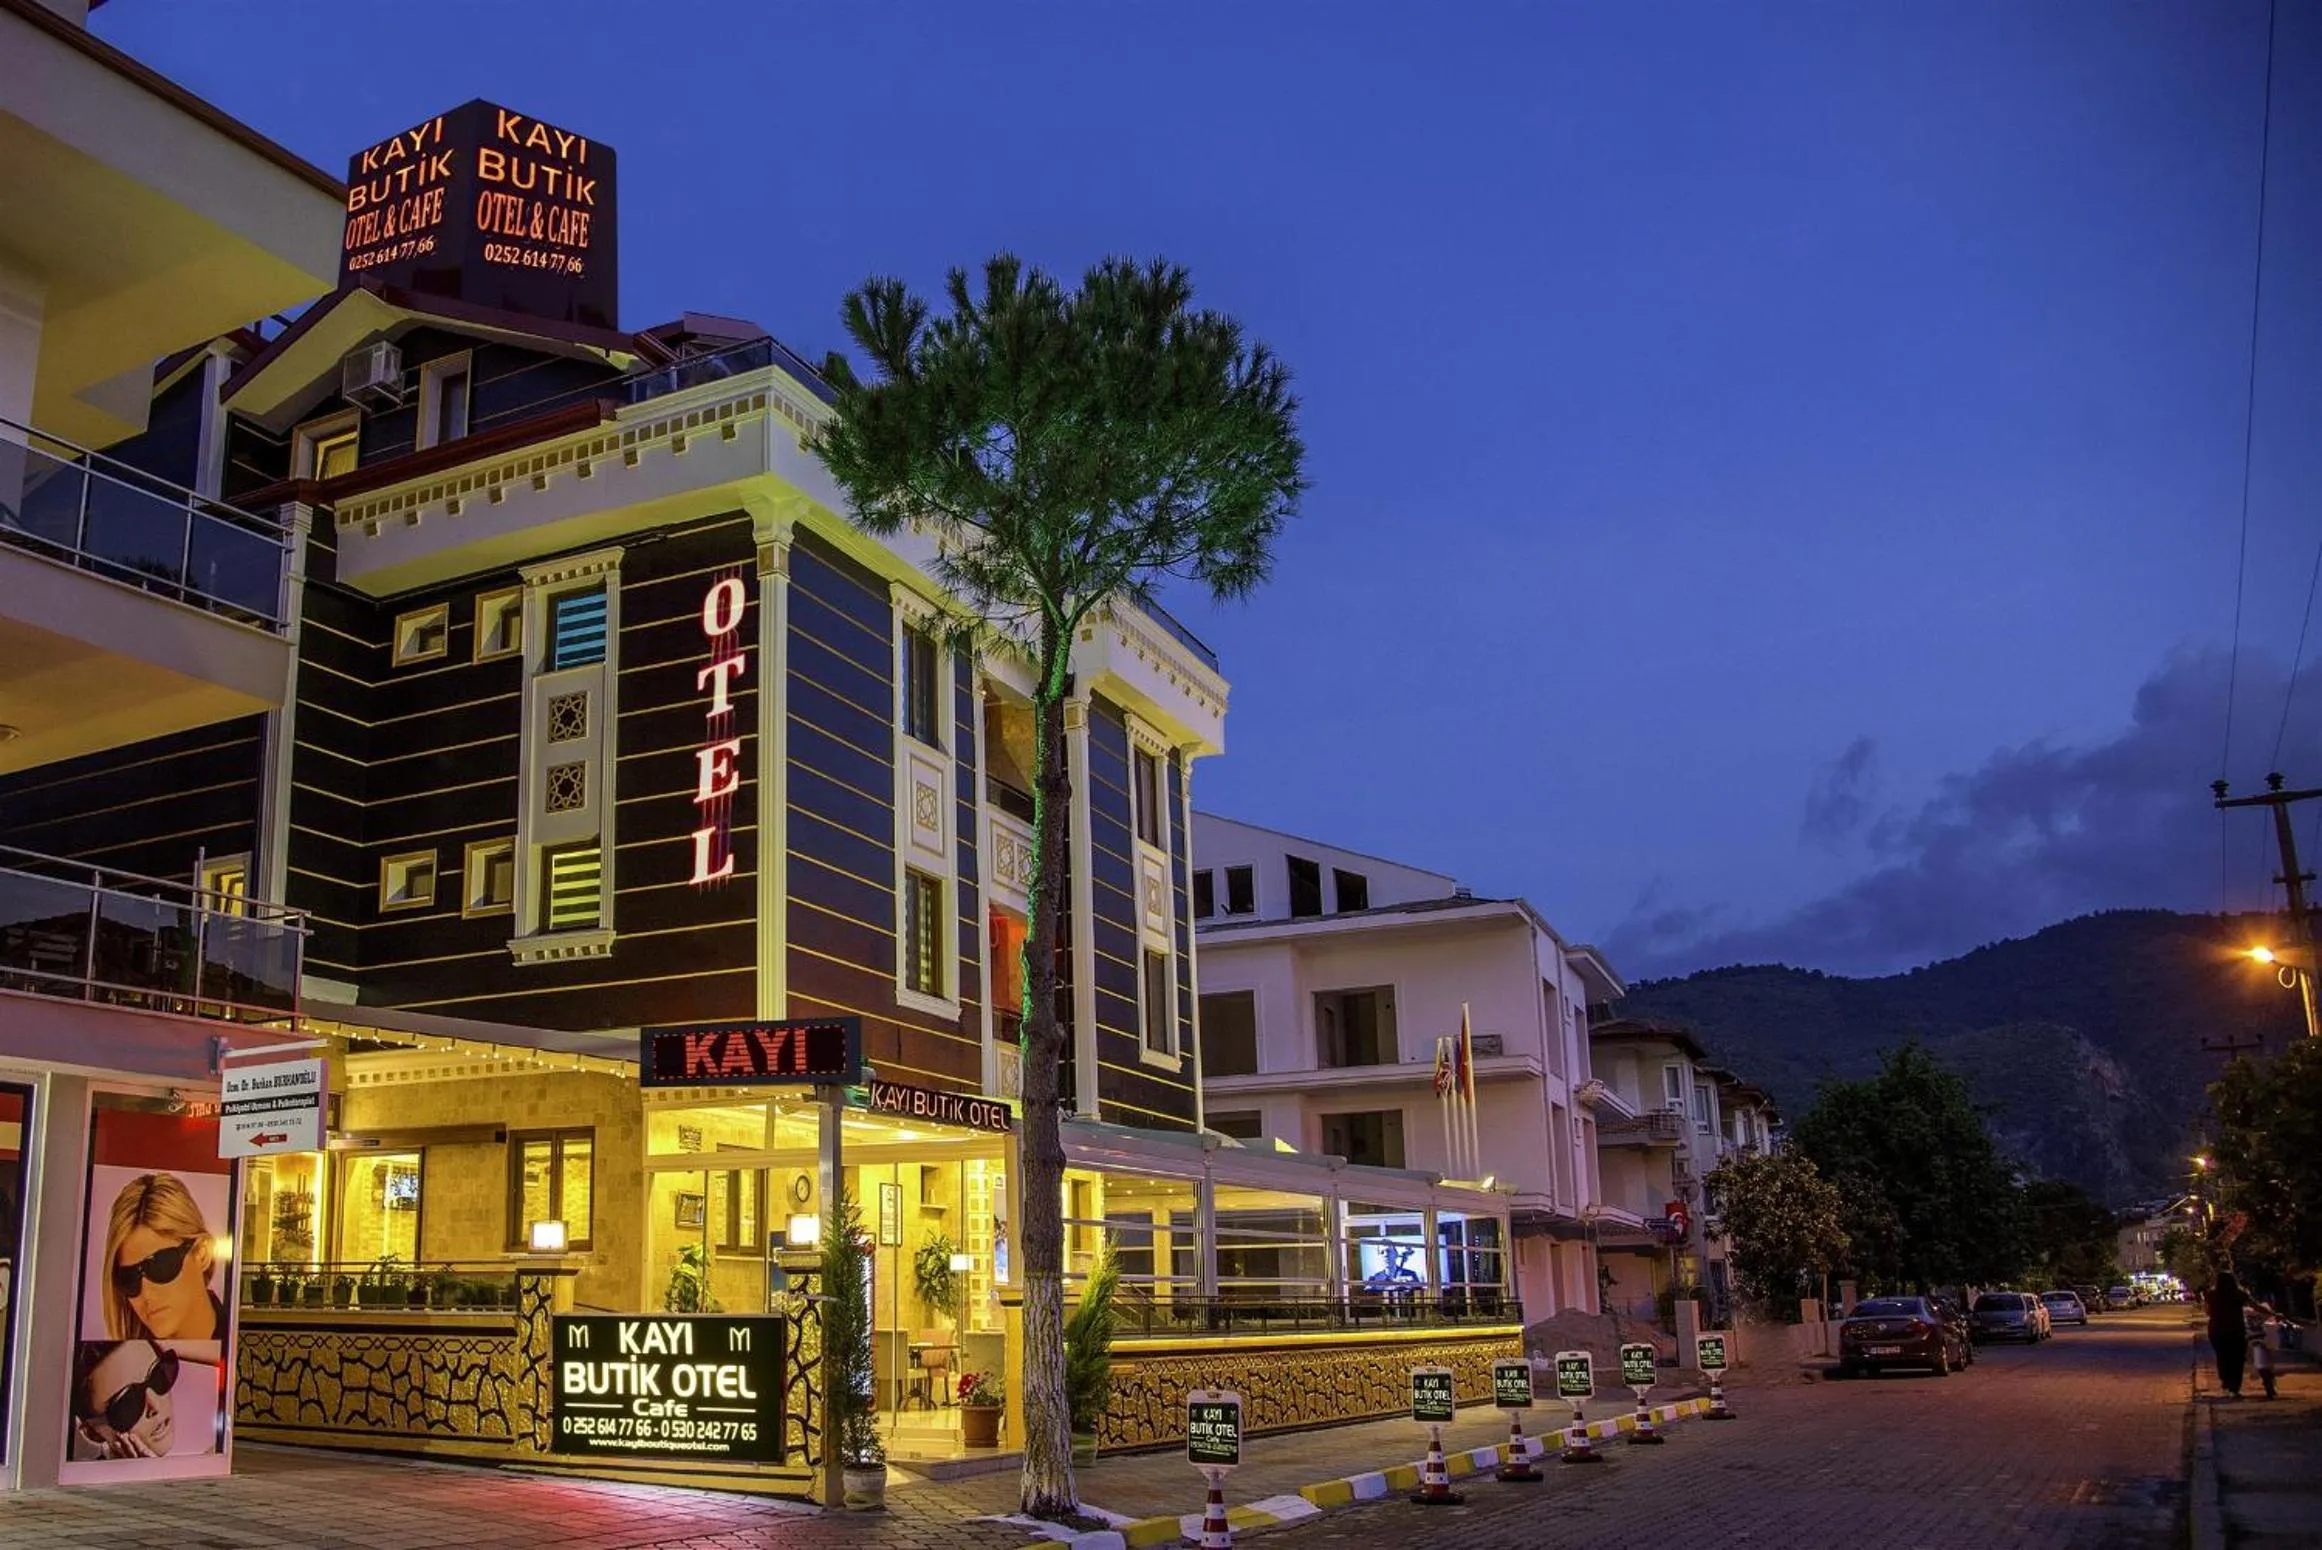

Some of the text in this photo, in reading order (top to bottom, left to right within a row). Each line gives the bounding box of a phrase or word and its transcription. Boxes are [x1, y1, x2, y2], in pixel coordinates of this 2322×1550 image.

[362, 117, 443, 174] KAYI
[498, 109, 586, 164] KAYI
[346, 187, 445, 250] OTEL & CAFE
[477, 190, 590, 248] OTEL & CAFE
[349, 235, 434, 271] 0252 614 77 66
[484, 243, 583, 273] 0252 614 77 66
[689, 577, 745, 885] OTEL
[686, 1028, 807, 1074] KAYI
[871, 1083, 911, 1112] KAYI
[969, 1101, 1010, 1130] OTEL
[618, 1321, 693, 1355] KAYI
[563, 1354, 757, 1399] BUTİK OTEL
[562, 1416, 572, 1434] 0
[573, 1416, 596, 1435] 252
[597, 1417, 617, 1436] 614
[618, 1418, 634, 1436] 77
[635, 1419, 652, 1437] 66
[661, 1420, 670, 1438] 0
[671, 1420, 695, 1439] 530
[697, 1421, 721, 1440] 242
[722, 1421, 739, 1440] 77
[740, 1422, 757, 1441] 65
[632, 1398, 688, 1417] Cafe
[1203, 1408, 1222, 1420] KAYI
[1215, 1423, 1238, 1437] OTEL
